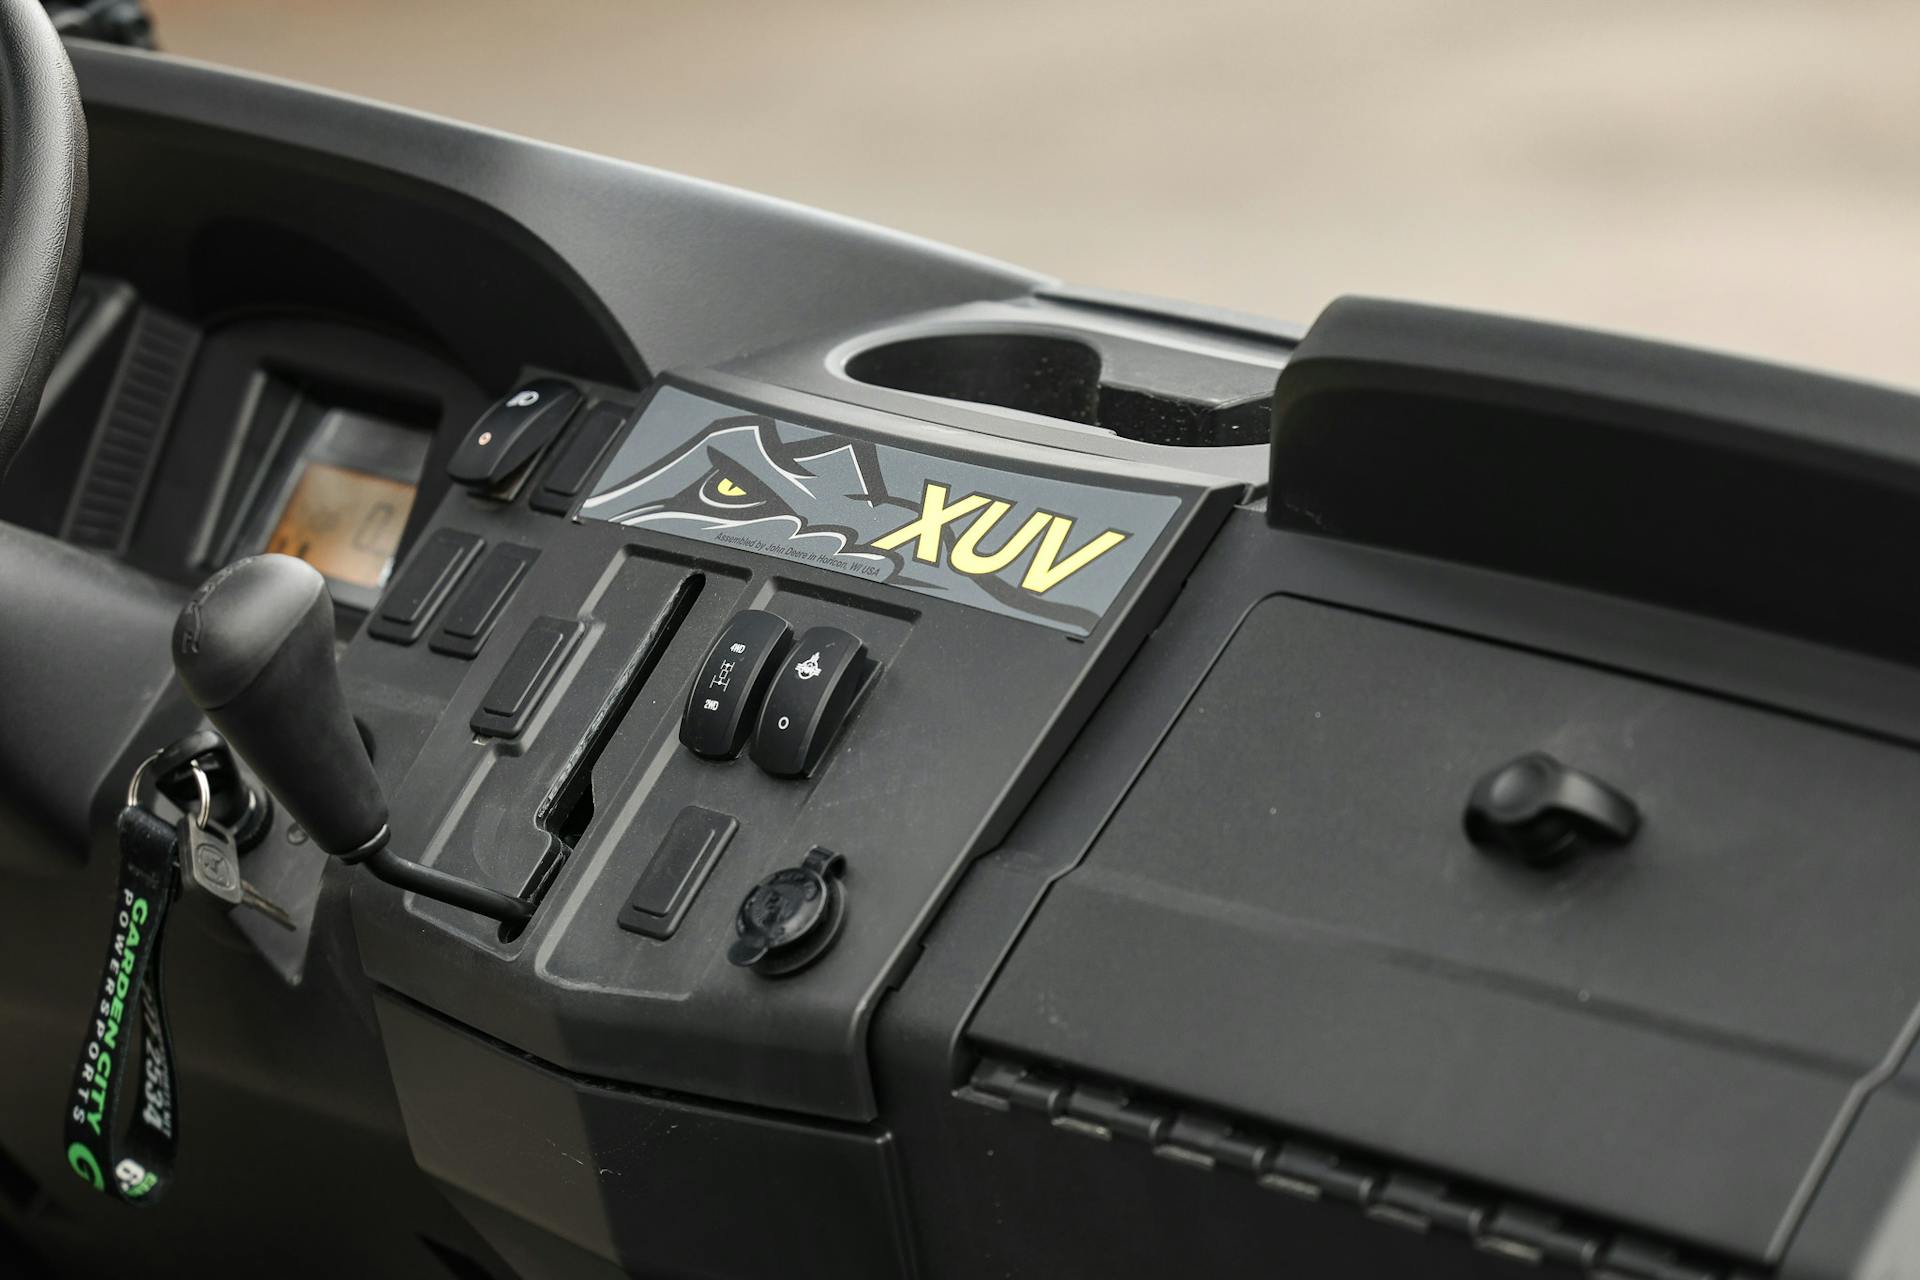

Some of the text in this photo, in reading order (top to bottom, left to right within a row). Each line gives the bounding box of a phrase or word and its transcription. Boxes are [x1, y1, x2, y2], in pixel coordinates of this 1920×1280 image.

[714, 532, 756, 548] Assembled
[755, 541, 765, 551] by
[765, 543, 785, 555] John
[786, 546, 808, 560] Deere
[808, 551, 816, 562] in
[850, 560, 863, 573] WI
[861, 563, 881, 577] USA
[869, 478, 1128, 596] XUV
[729, 642, 747, 654] 4WD
[703, 699, 720, 711] 2WD
[72, 888, 134, 1124] POWERSPORTS
[84, 897, 149, 1136] GARDEN CITY
